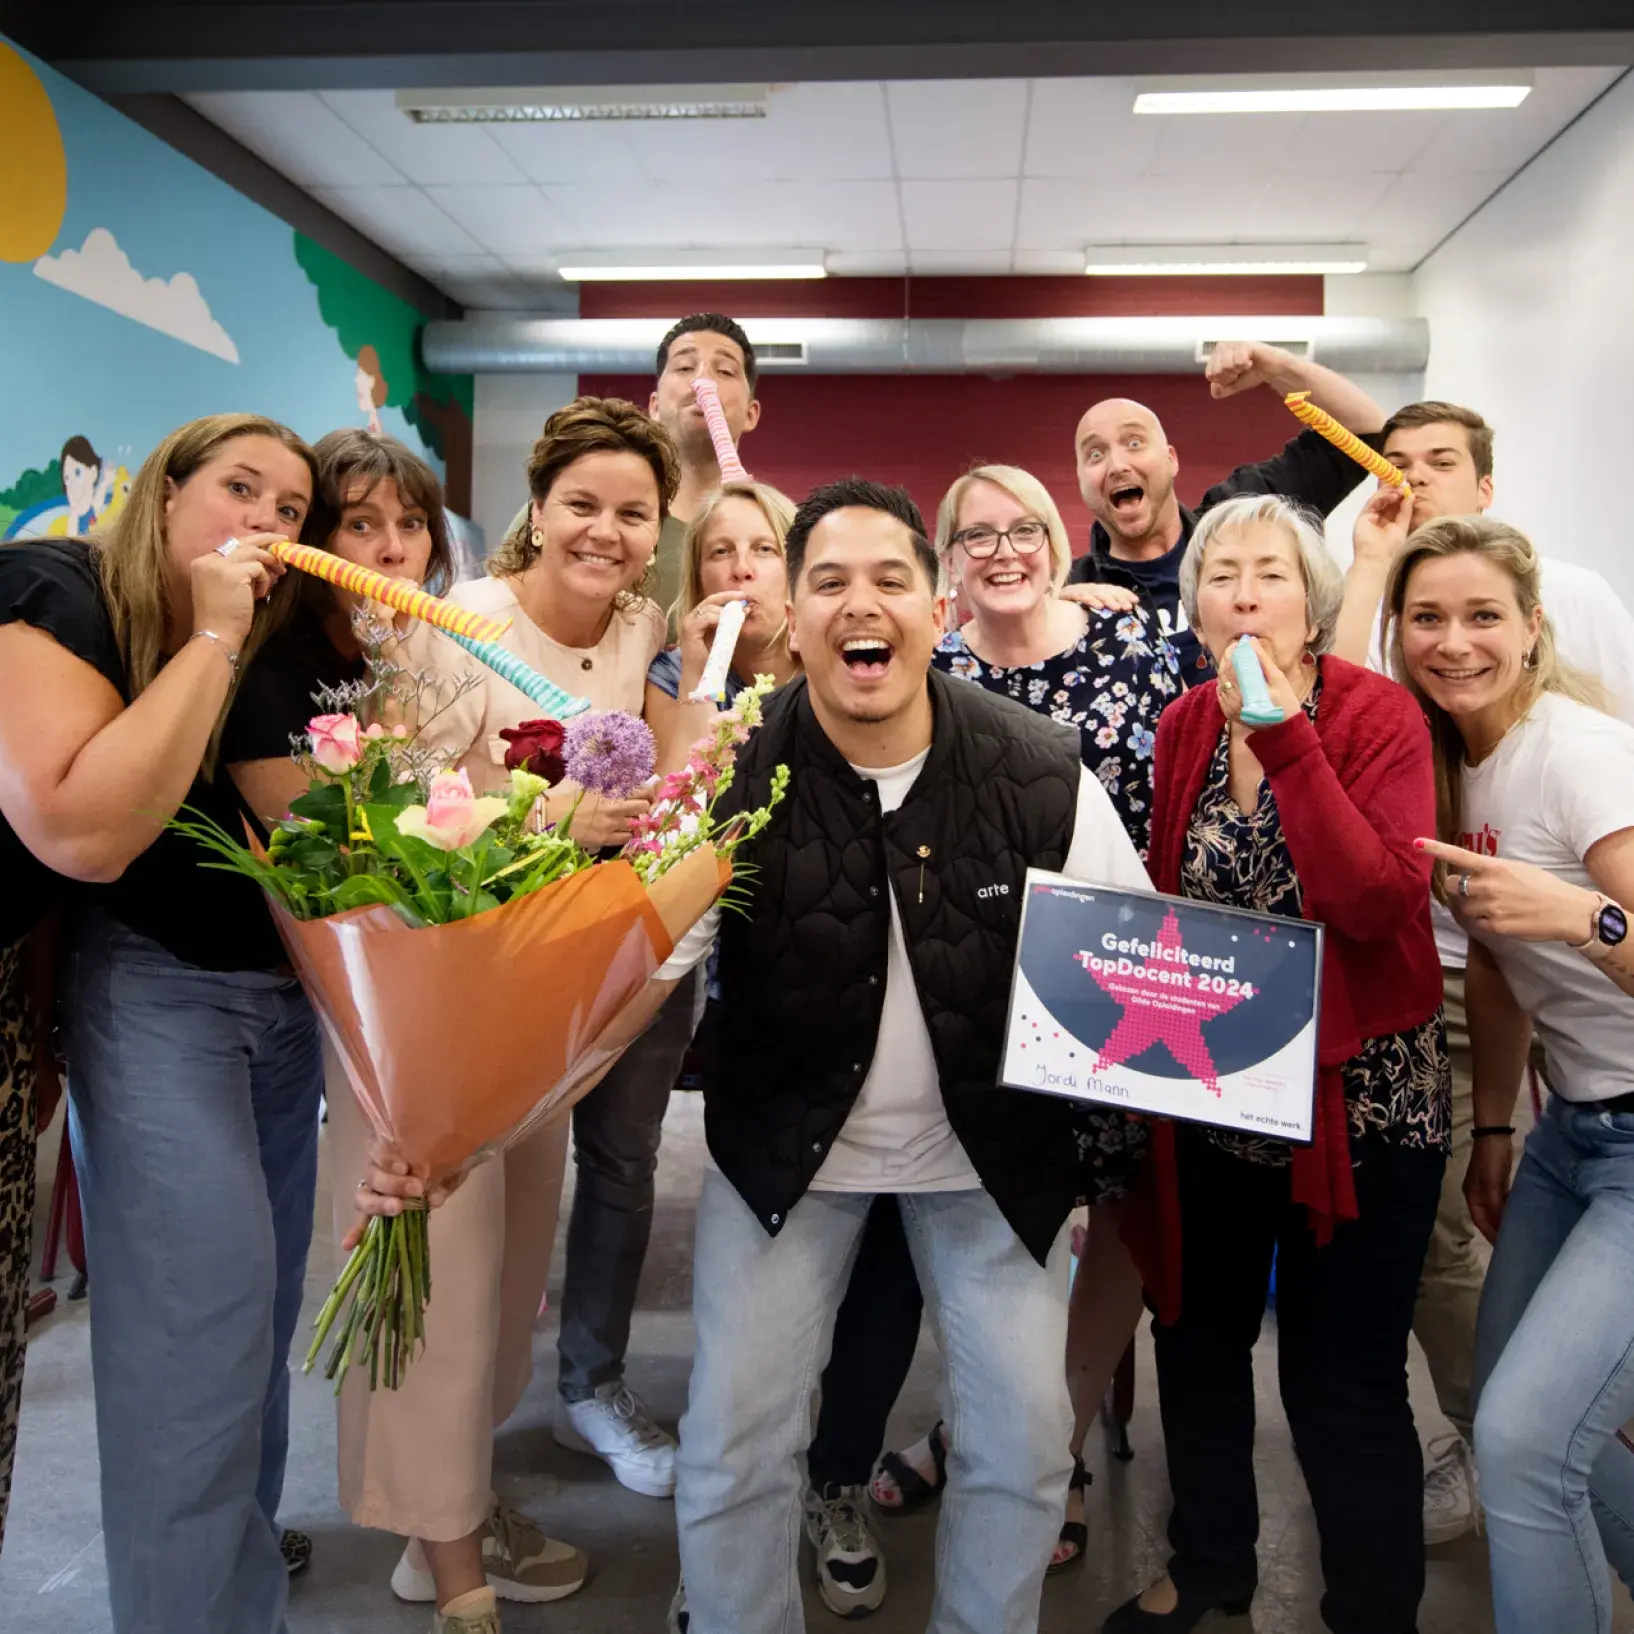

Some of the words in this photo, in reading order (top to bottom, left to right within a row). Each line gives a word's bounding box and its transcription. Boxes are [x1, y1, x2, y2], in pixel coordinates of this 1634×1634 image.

[977, 883, 1010, 899] arte
[1101, 933, 1235, 973] Gefeliciteerd
[1079, 950, 1192, 988] TopDocent
[1197, 973, 1254, 999] 2024
[1131, 995, 1151, 1006] Gilde
[1152, 999, 1196, 1014] Opleidingen
[1140, 989, 1158, 998] door
[1159, 992, 1168, 1000] de
[1170, 995, 1206, 1007] studenten
[1208, 1002, 1221, 1010] van
[1032, 1064, 1077, 1087] Jordi
[1087, 1076, 1130, 1098] Mann
[1240, 1111, 1254, 1121] het
[1255, 1116, 1279, 1126] echte
